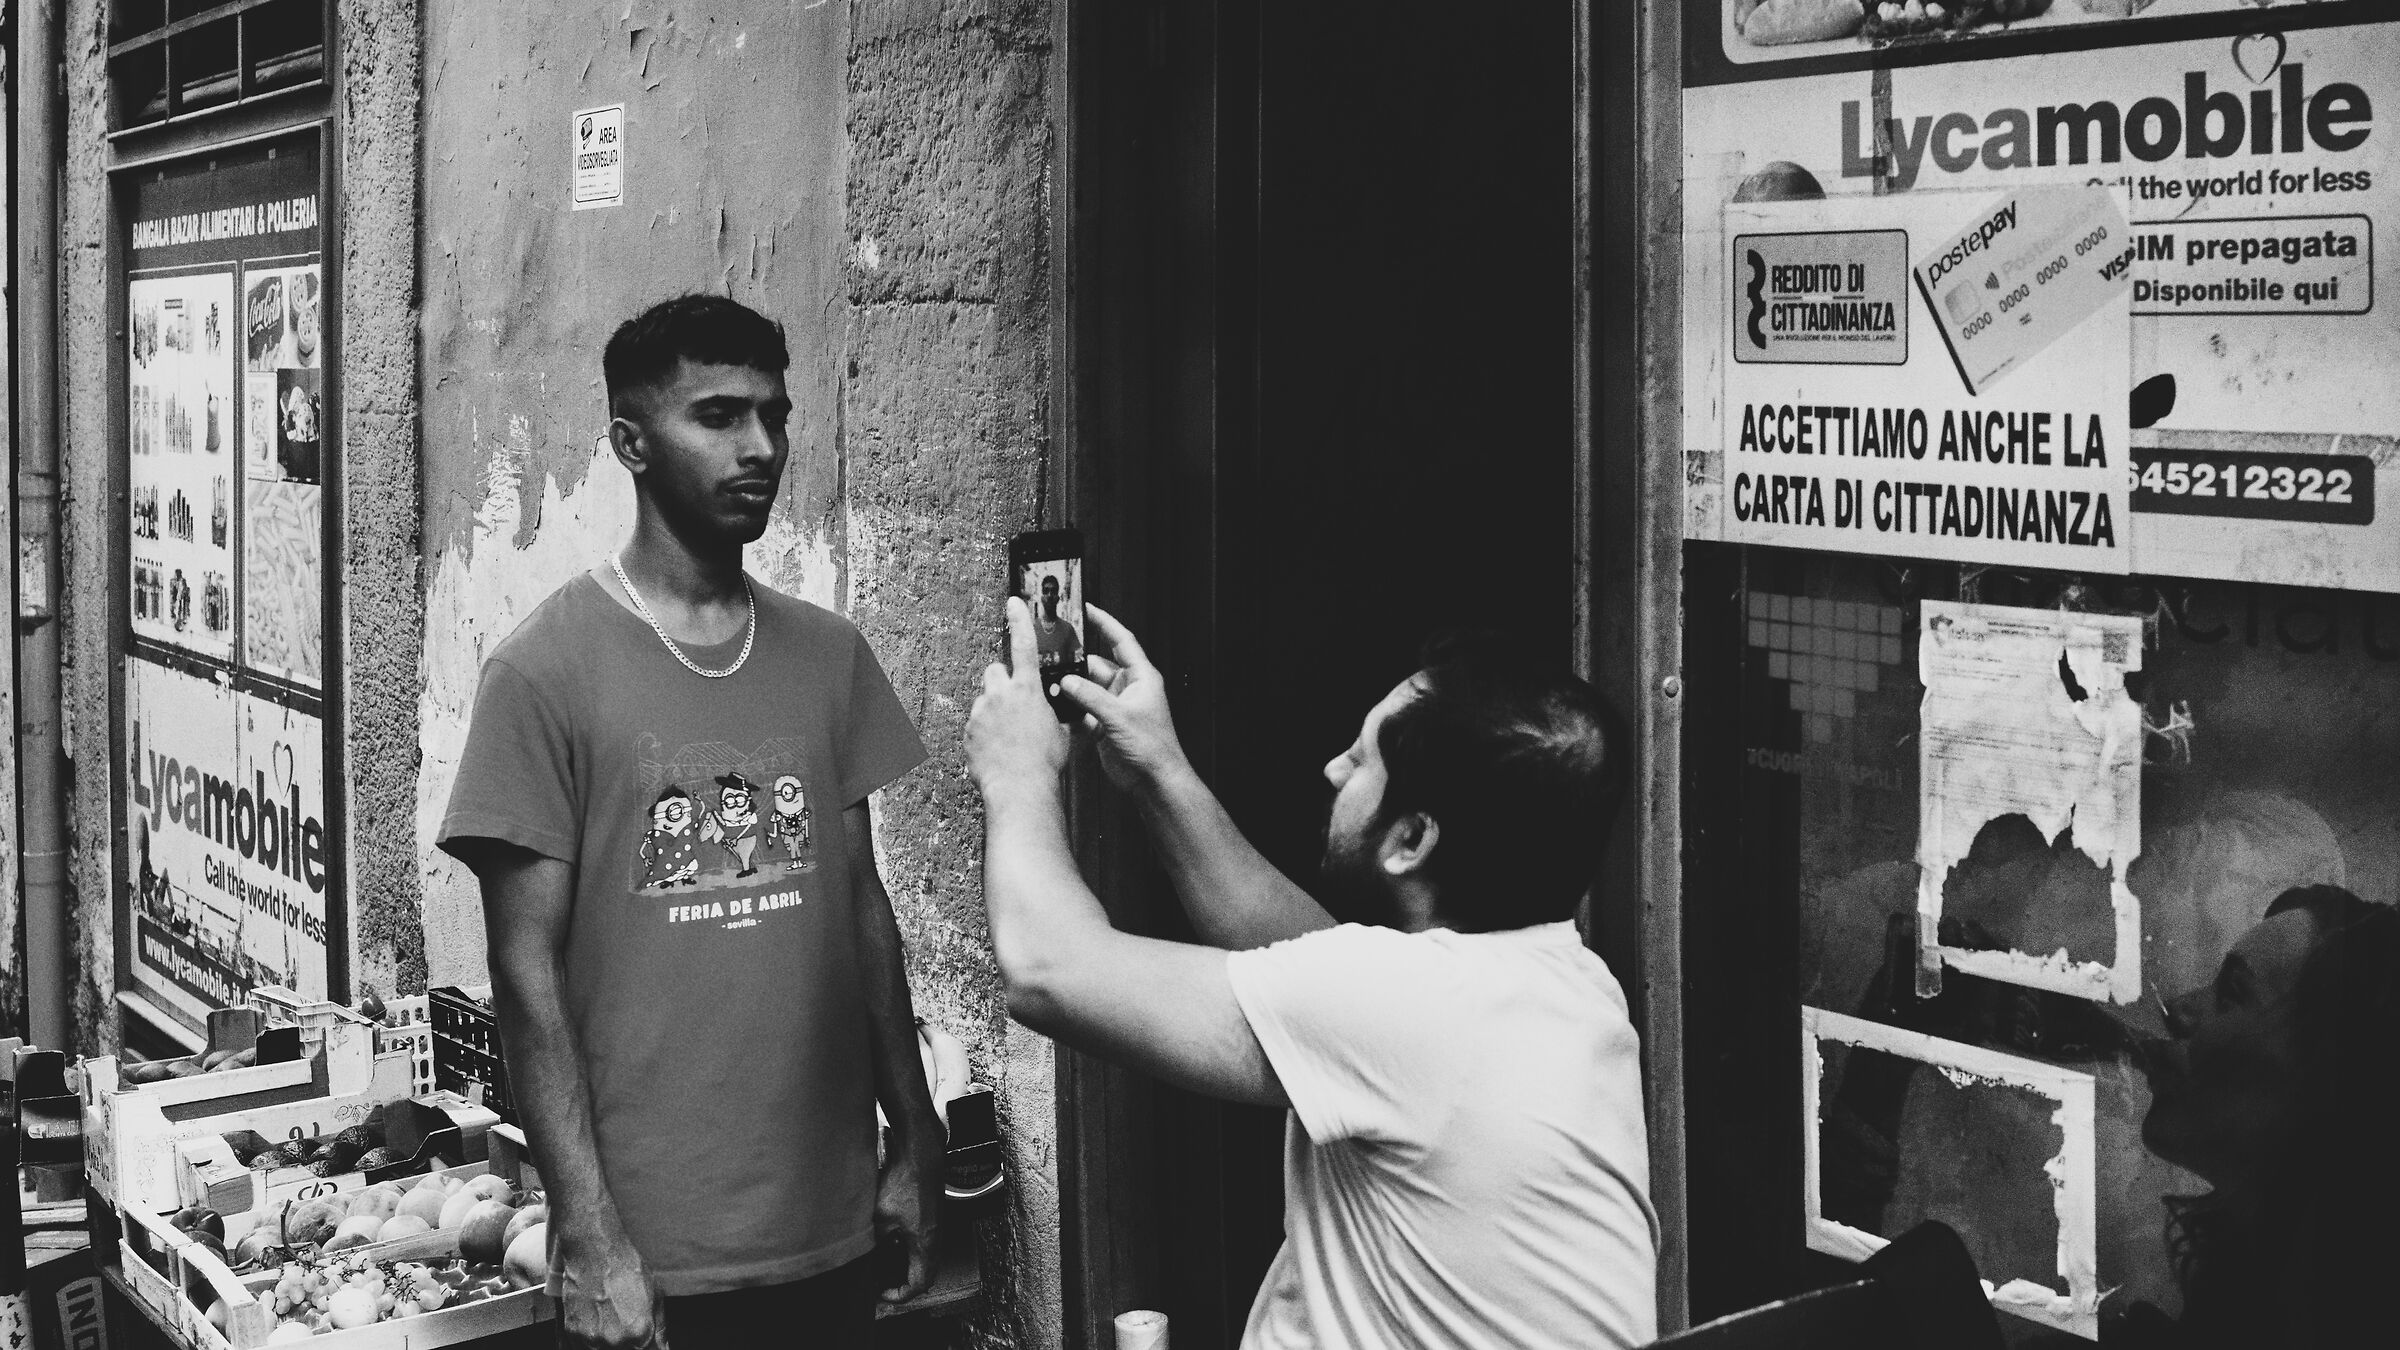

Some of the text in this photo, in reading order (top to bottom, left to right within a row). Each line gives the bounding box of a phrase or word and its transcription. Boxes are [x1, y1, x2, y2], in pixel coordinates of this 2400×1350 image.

[598, 126, 617, 145] AREA
[1841, 60, 2374, 194] Lycamobile
[2138, 176, 2182, 199] the
[2187, 170, 2263, 197] world
[2269, 169, 2309, 194] for
[2313, 167, 2371, 192] less
[170, 213, 199, 246] BAZAR
[200, 204, 256, 242] ALIMENTARI
[257, 203, 266, 235] &
[267, 194, 318, 233] POLLERIA
[1928, 200, 2016, 289] postepay
[2130, 230, 2358, 266] IM prepagata
[1771, 263, 1865, 293] REDDITO DI
[2132, 276, 2339, 306] Disponibile qui
[1771, 301, 1896, 332] CITTADINANZA
[1740, 403, 2108, 468] ACCETTIAMO ANCHE LA
[1734, 472, 2116, 548] CARTA DI CITTADINANZA
[132, 720, 325, 893] Lycamobile
[205, 853, 226, 891] Call
[227, 866, 246, 901] the
[247, 882, 281, 920] world
[301, 901, 326, 947] less
[669, 890, 803, 922] FERIA DE ABRIL
[727, 917, 757, 929] sevilla
[144, 933, 241, 1008] www.lycamobile.it
